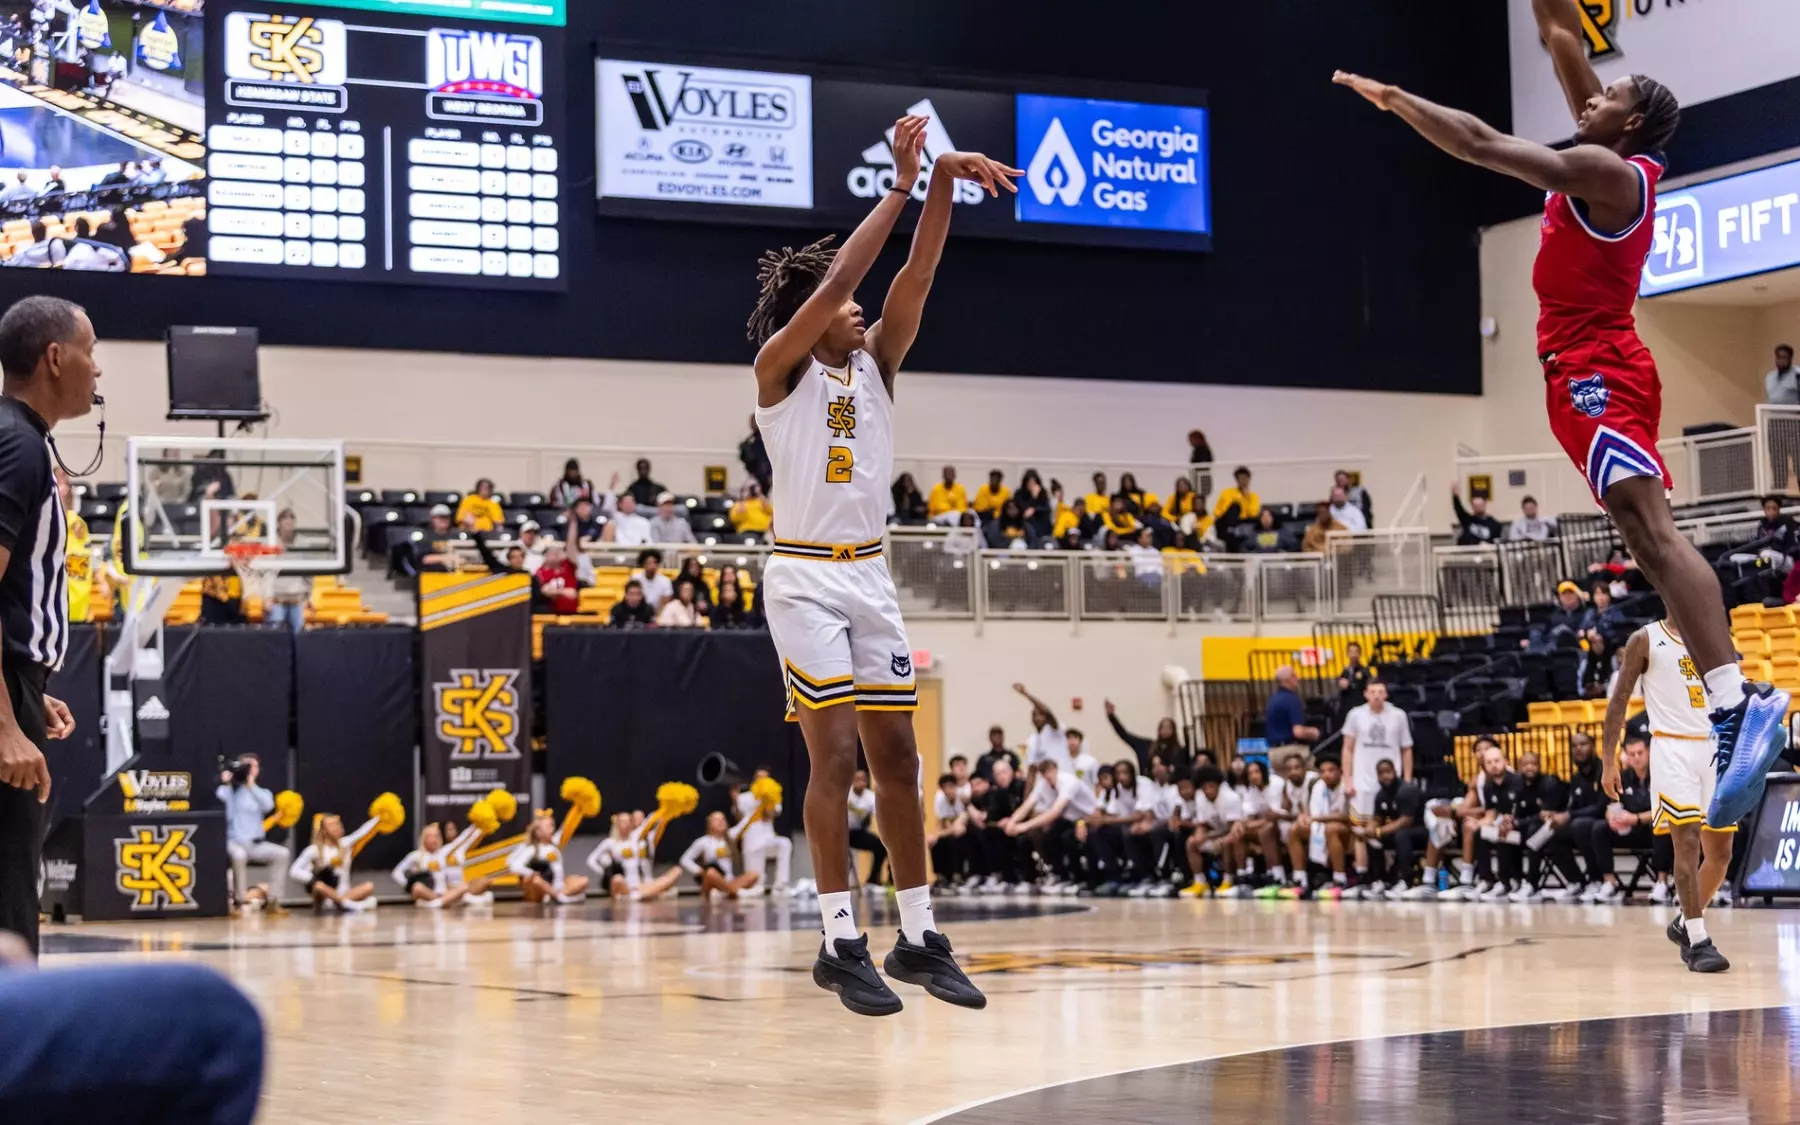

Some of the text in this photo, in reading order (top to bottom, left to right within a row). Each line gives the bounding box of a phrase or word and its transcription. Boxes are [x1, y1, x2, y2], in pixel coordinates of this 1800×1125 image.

[300, 90, 337, 105] STATE
[442, 99, 476, 114] WEST
[1091, 119, 1199, 158] Georgia
[1091, 151, 1198, 185] Natural
[1093, 182, 1149, 212] Gas
[825, 445, 855, 483] 2
[1686, 684, 1705, 708] 5
[1773, 837, 1796, 871] IS
